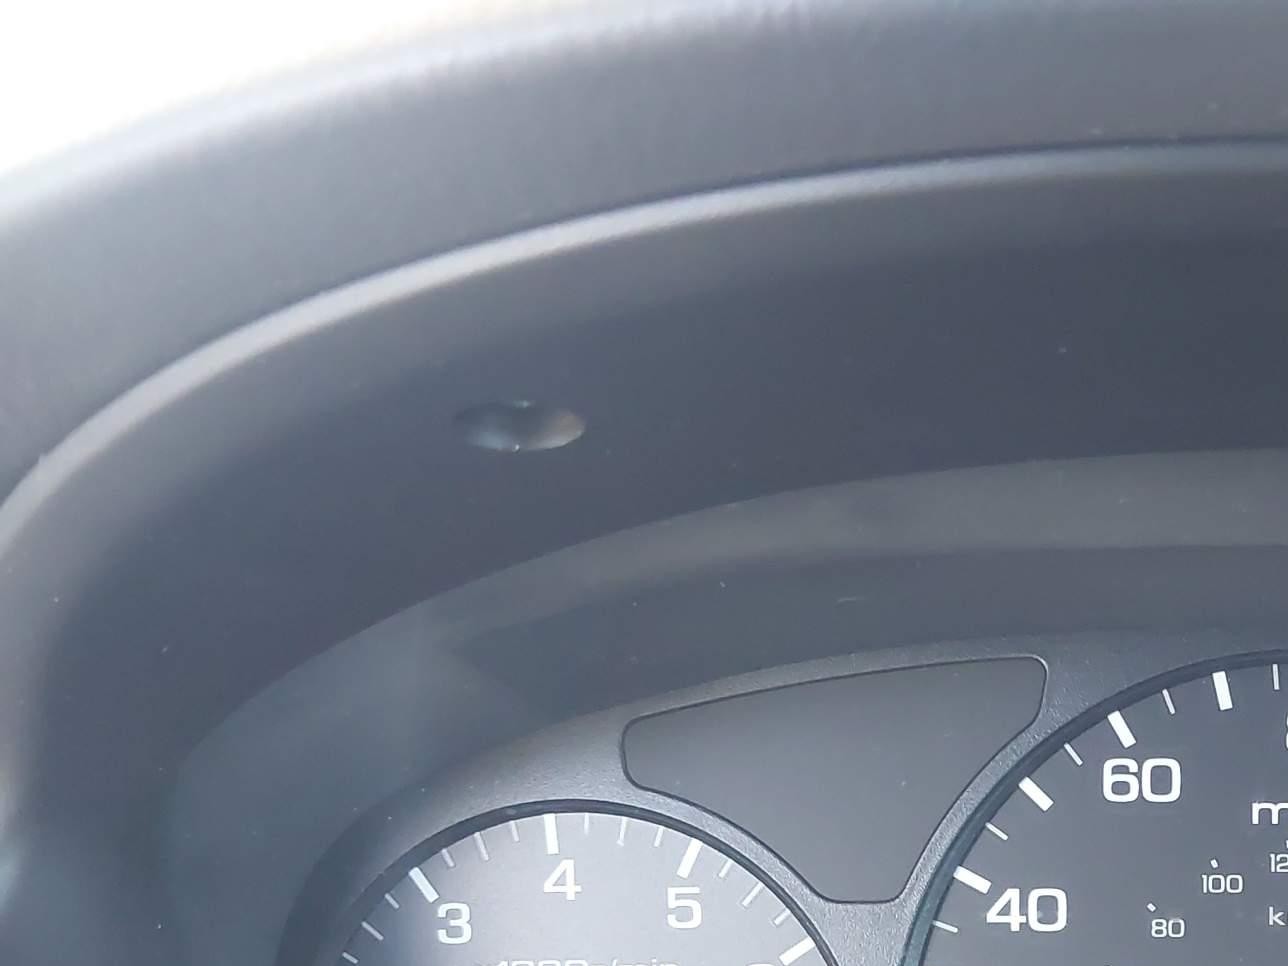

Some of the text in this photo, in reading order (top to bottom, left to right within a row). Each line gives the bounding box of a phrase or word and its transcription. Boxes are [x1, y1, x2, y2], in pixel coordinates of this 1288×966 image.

[1102, 757, 1182, 803] 60
[543, 859, 582, 901] 4
[1201, 874, 1243, 894] 100
[436, 902, 473, 944] 3
[667, 886, 702, 929] 5
[985, 888, 1068, 932] 40
[1150, 918, 1186, 938] 80
